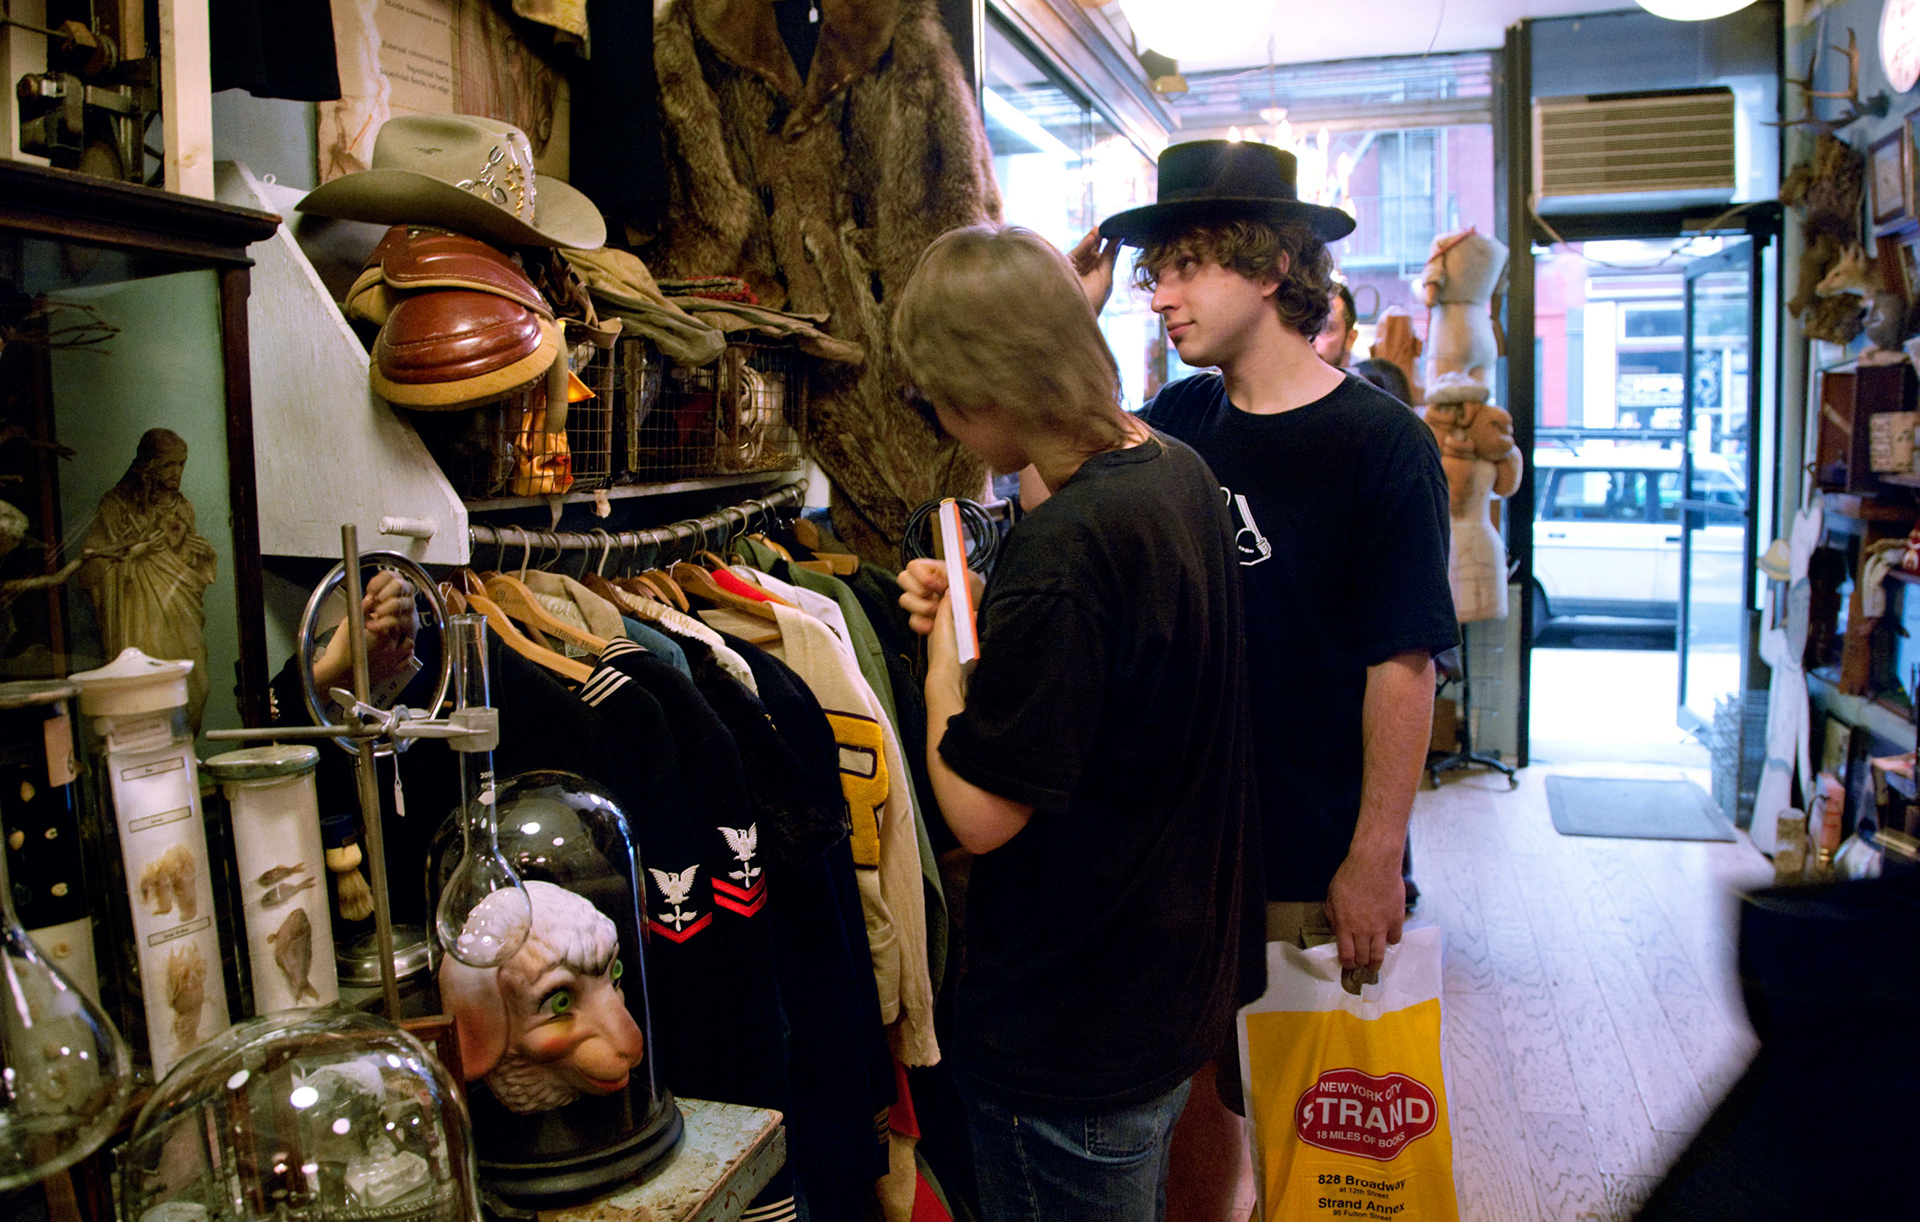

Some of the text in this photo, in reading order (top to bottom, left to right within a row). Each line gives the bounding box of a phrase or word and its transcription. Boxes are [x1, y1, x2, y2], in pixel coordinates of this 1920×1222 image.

[553, 627, 578, 645] Hilton
[1320, 1082, 1402, 1102] NEW YORK CITY
[1303, 1097, 1430, 1133] STRAND
[1317, 1131, 1405, 1148] 18 MILES OF BOOKS
[1318, 1174, 1406, 1192] 828 Broadway
[1349, 1187, 1365, 1195] 12th
[1366, 1190, 1389, 1199] Street
[1318, 1198, 1405, 1214] Strand Annex
[1343, 1210, 1368, 1218] Fulton
[1369, 1212, 1392, 1221] Street
